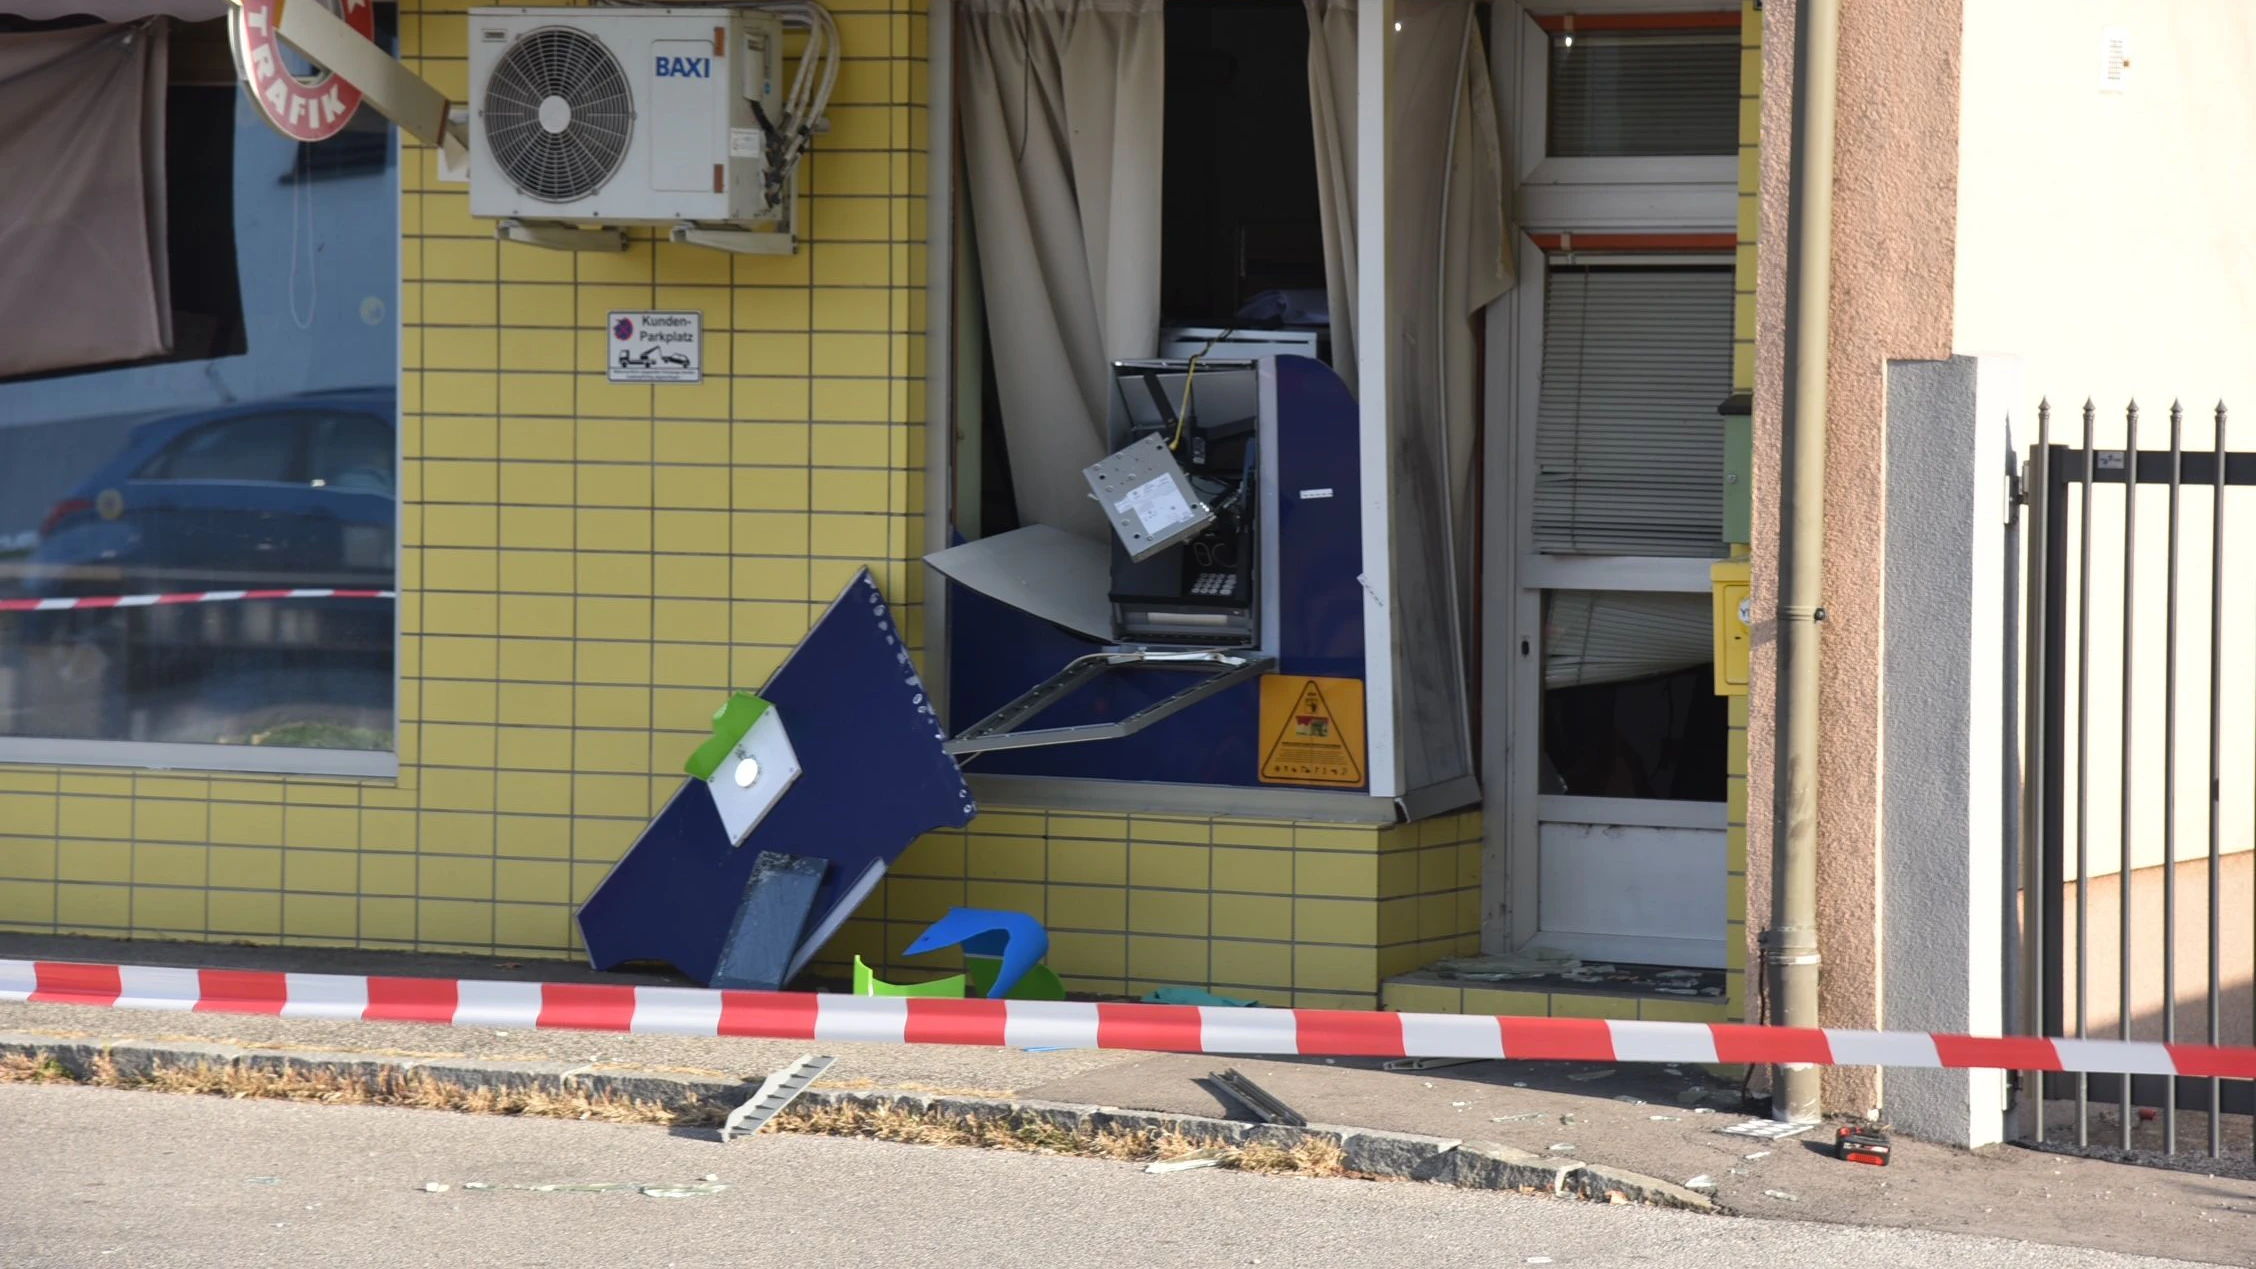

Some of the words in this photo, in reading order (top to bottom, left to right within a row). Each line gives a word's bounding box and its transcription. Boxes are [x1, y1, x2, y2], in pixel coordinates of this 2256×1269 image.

[248, 5, 346, 129] TRAFIK
[655, 56, 711, 78] BAXI
[641, 315, 692, 327] Kunden-
[639, 330, 694, 345] Parkplatz
